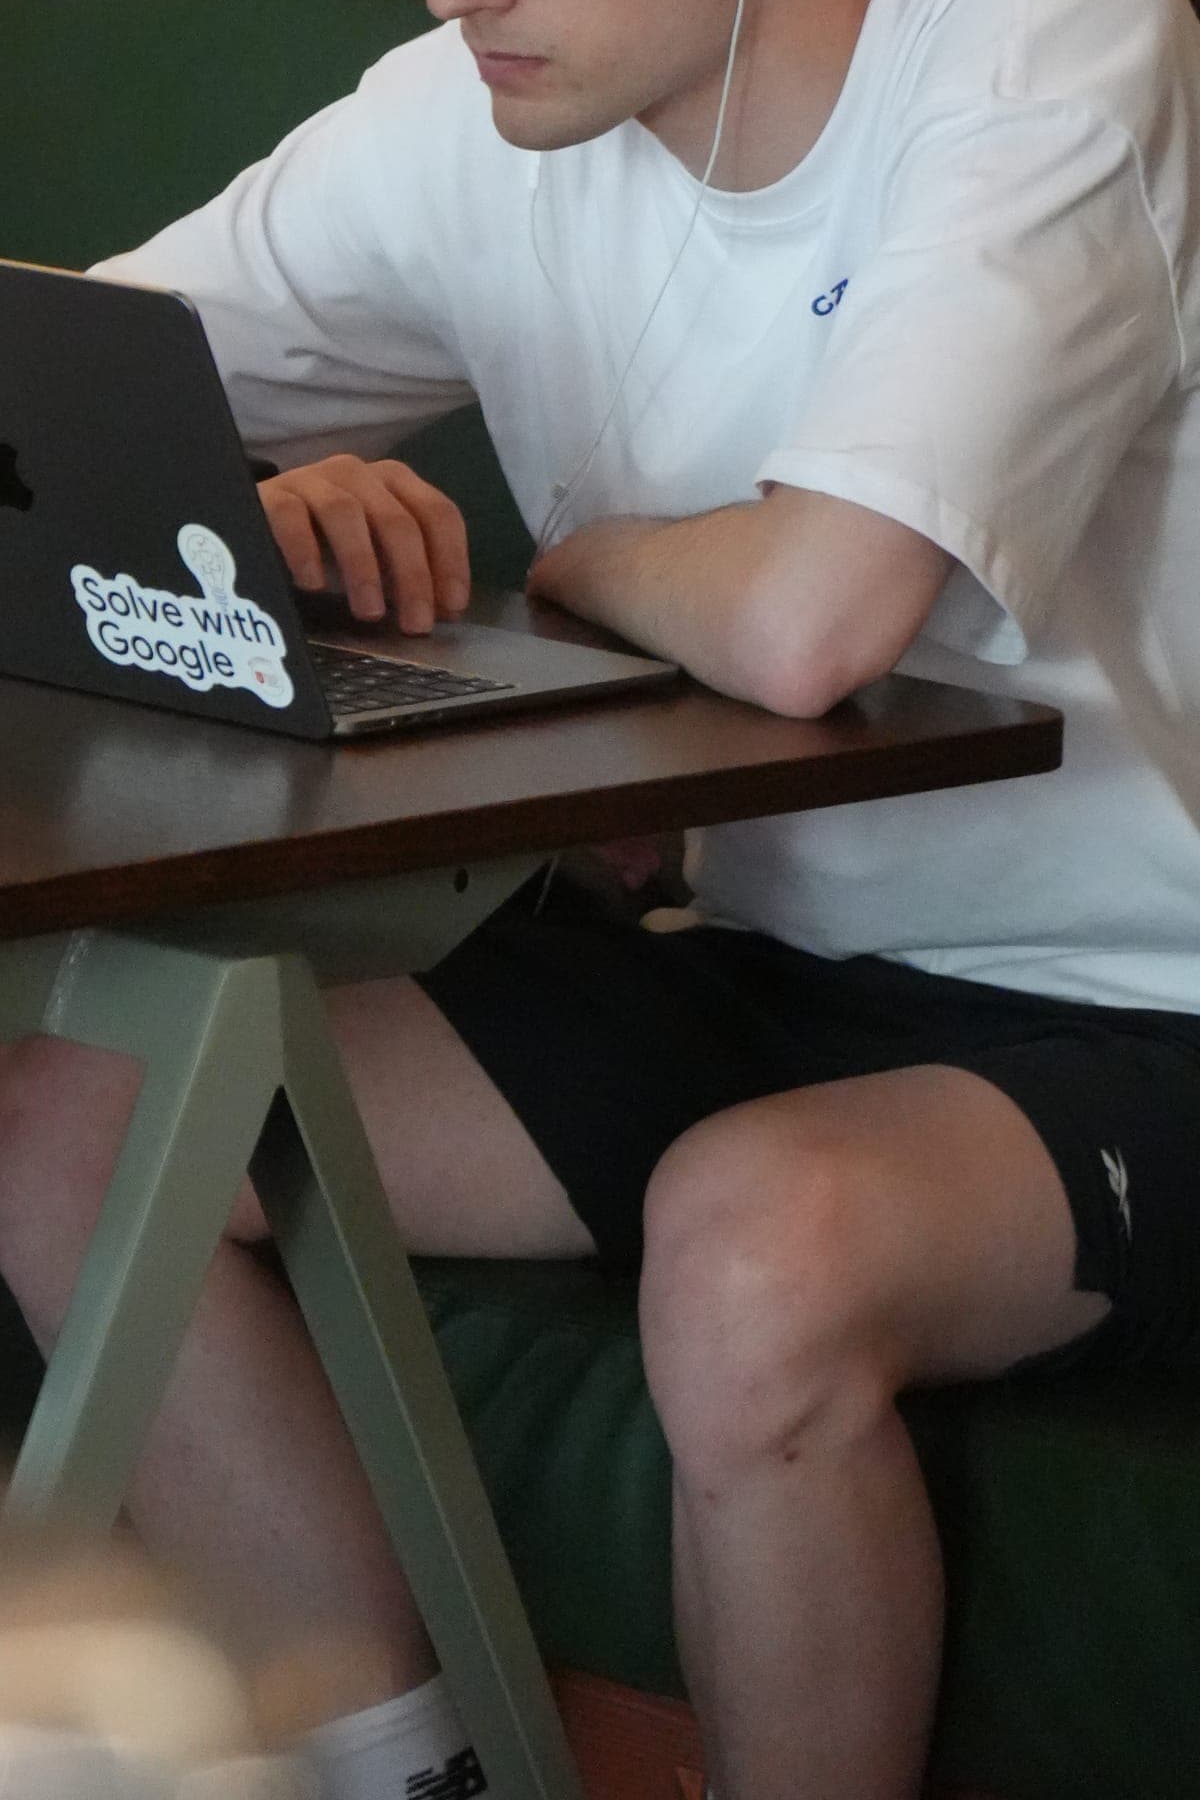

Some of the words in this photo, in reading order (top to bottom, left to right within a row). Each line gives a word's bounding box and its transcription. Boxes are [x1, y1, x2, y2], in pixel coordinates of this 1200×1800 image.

[81, 576, 184, 628] Solve
[190, 606, 276, 646] with
[97, 621, 235, 681] Google
